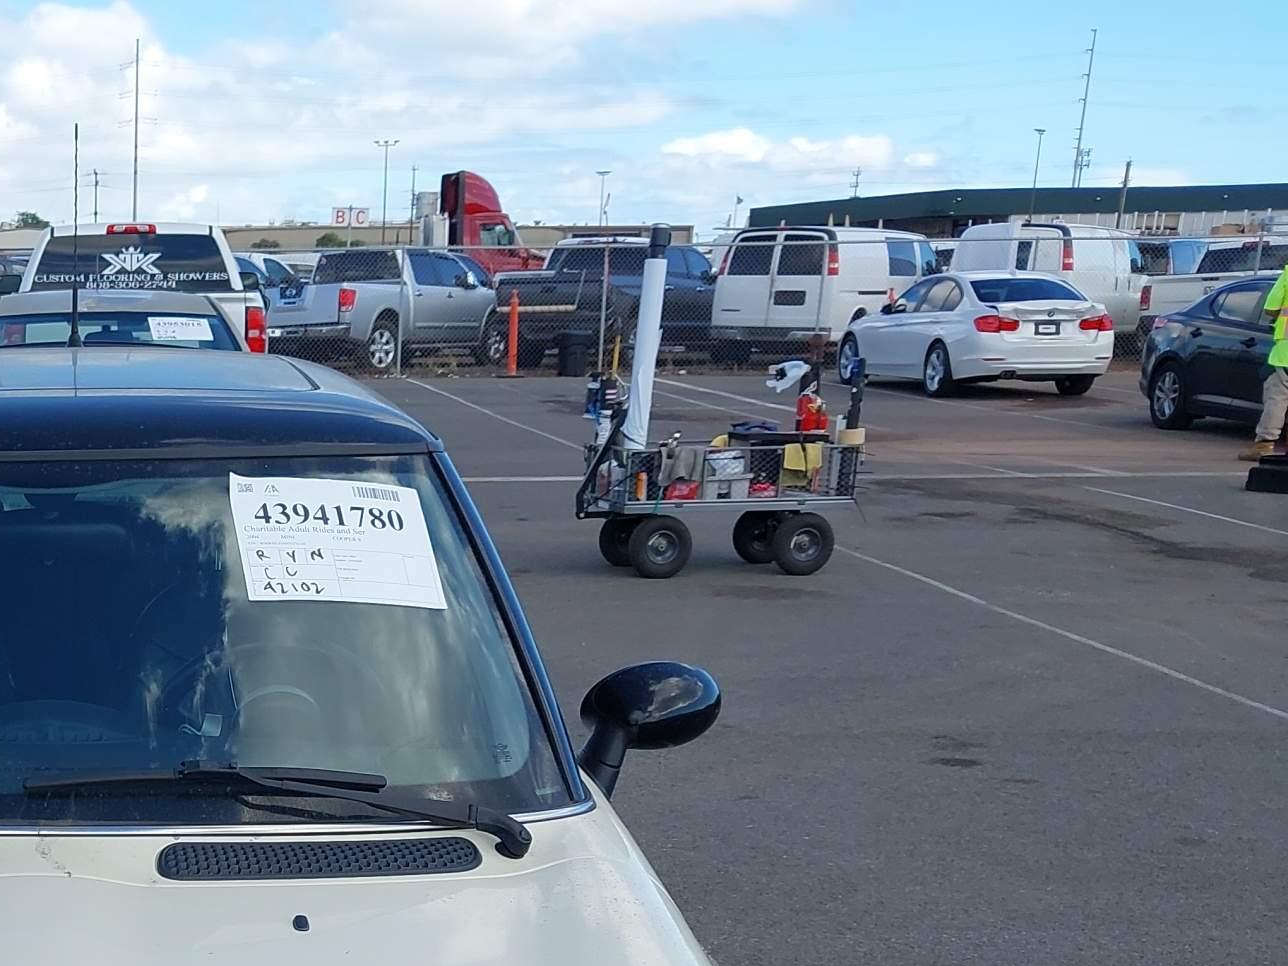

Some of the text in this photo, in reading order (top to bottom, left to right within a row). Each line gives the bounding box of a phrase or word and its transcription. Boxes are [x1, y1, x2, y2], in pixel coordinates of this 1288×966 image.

[335, 210, 366, 225] B C
[34, 273, 85, 283] CUSTOM
[89, 273, 150, 282] FLOORING
[167, 272, 228, 281] SHOWERS
[254, 502, 405, 532] 43941780
[244, 525, 286, 534] Charitable
[256, 548, 324, 563] R Y N
